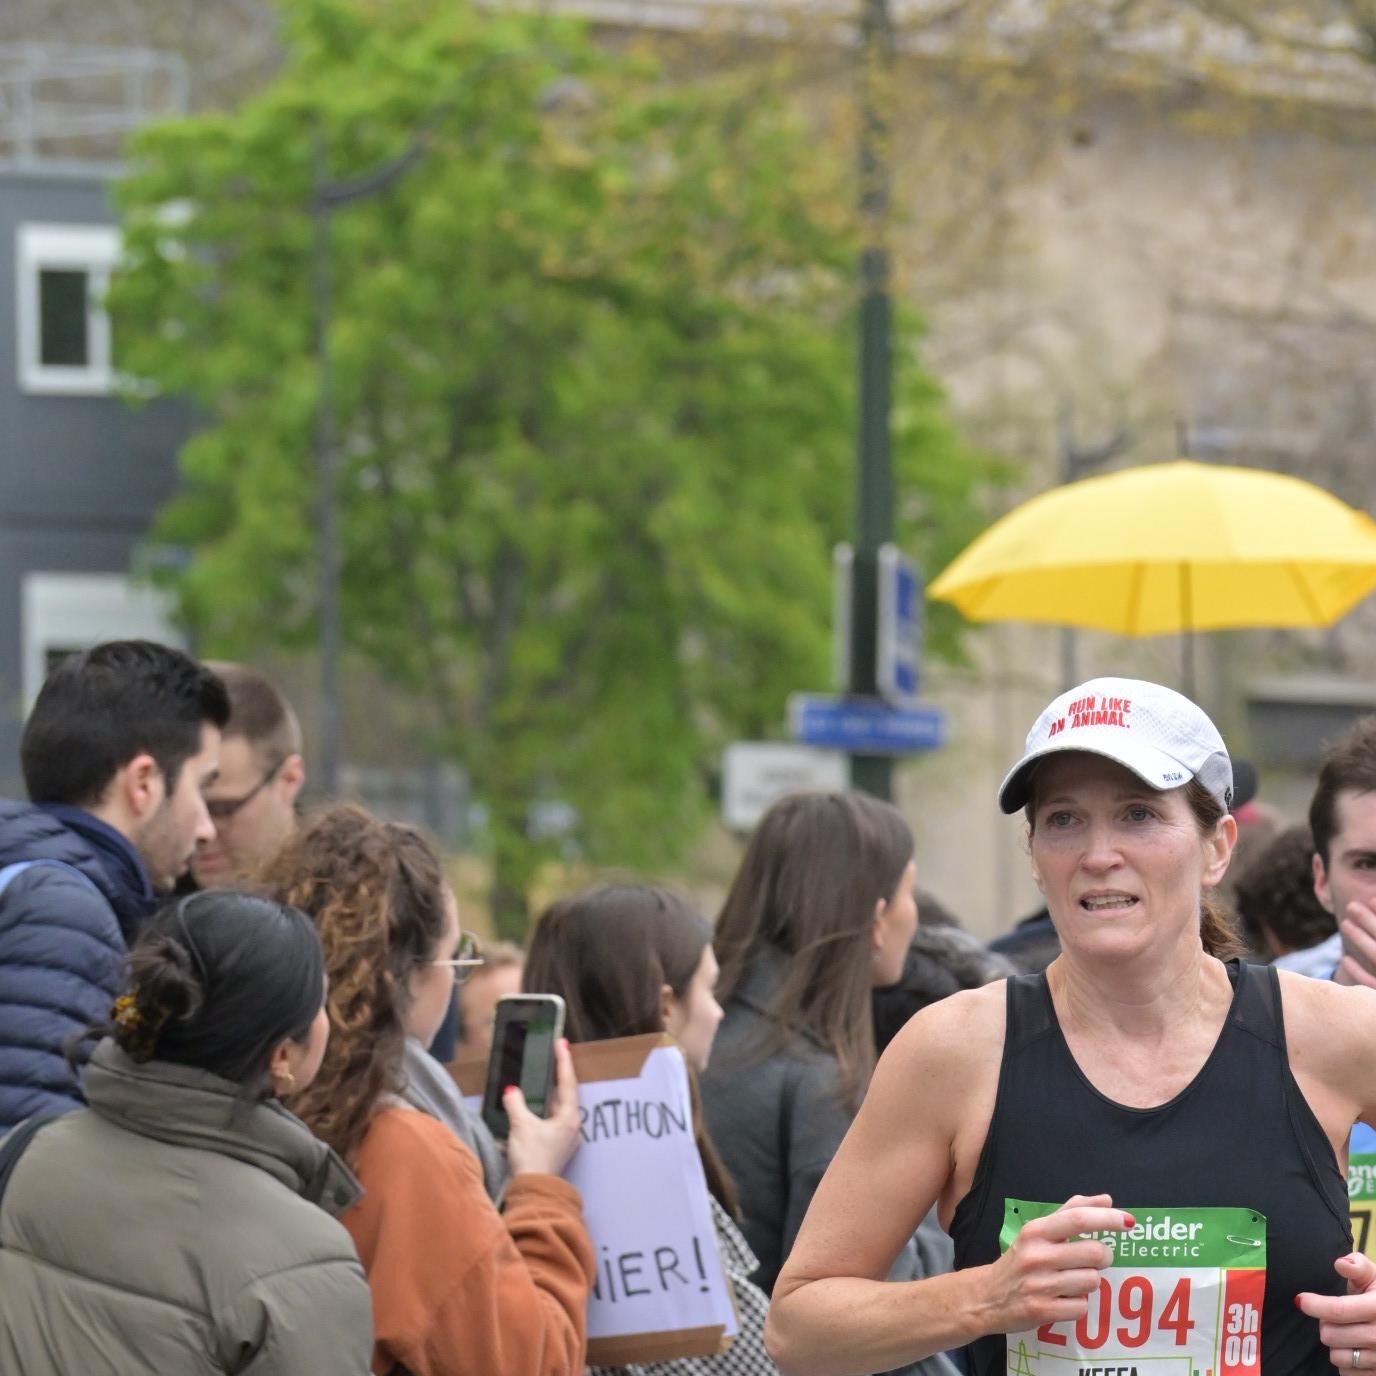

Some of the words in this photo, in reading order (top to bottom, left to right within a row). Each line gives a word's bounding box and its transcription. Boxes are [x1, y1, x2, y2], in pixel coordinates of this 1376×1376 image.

[1068, 695, 1096, 716] RUN
[1101, 697, 1133, 713] LIKE
[1048, 718, 1066, 738] AN
[1071, 710, 1131, 729] ANIMAL.
[1079, 1215, 1204, 1241] eider
[1119, 1241, 1201, 1258] Electric
[1226, 1303, 1259, 1334] 3h
[1224, 1334, 1258, 1367] 00
